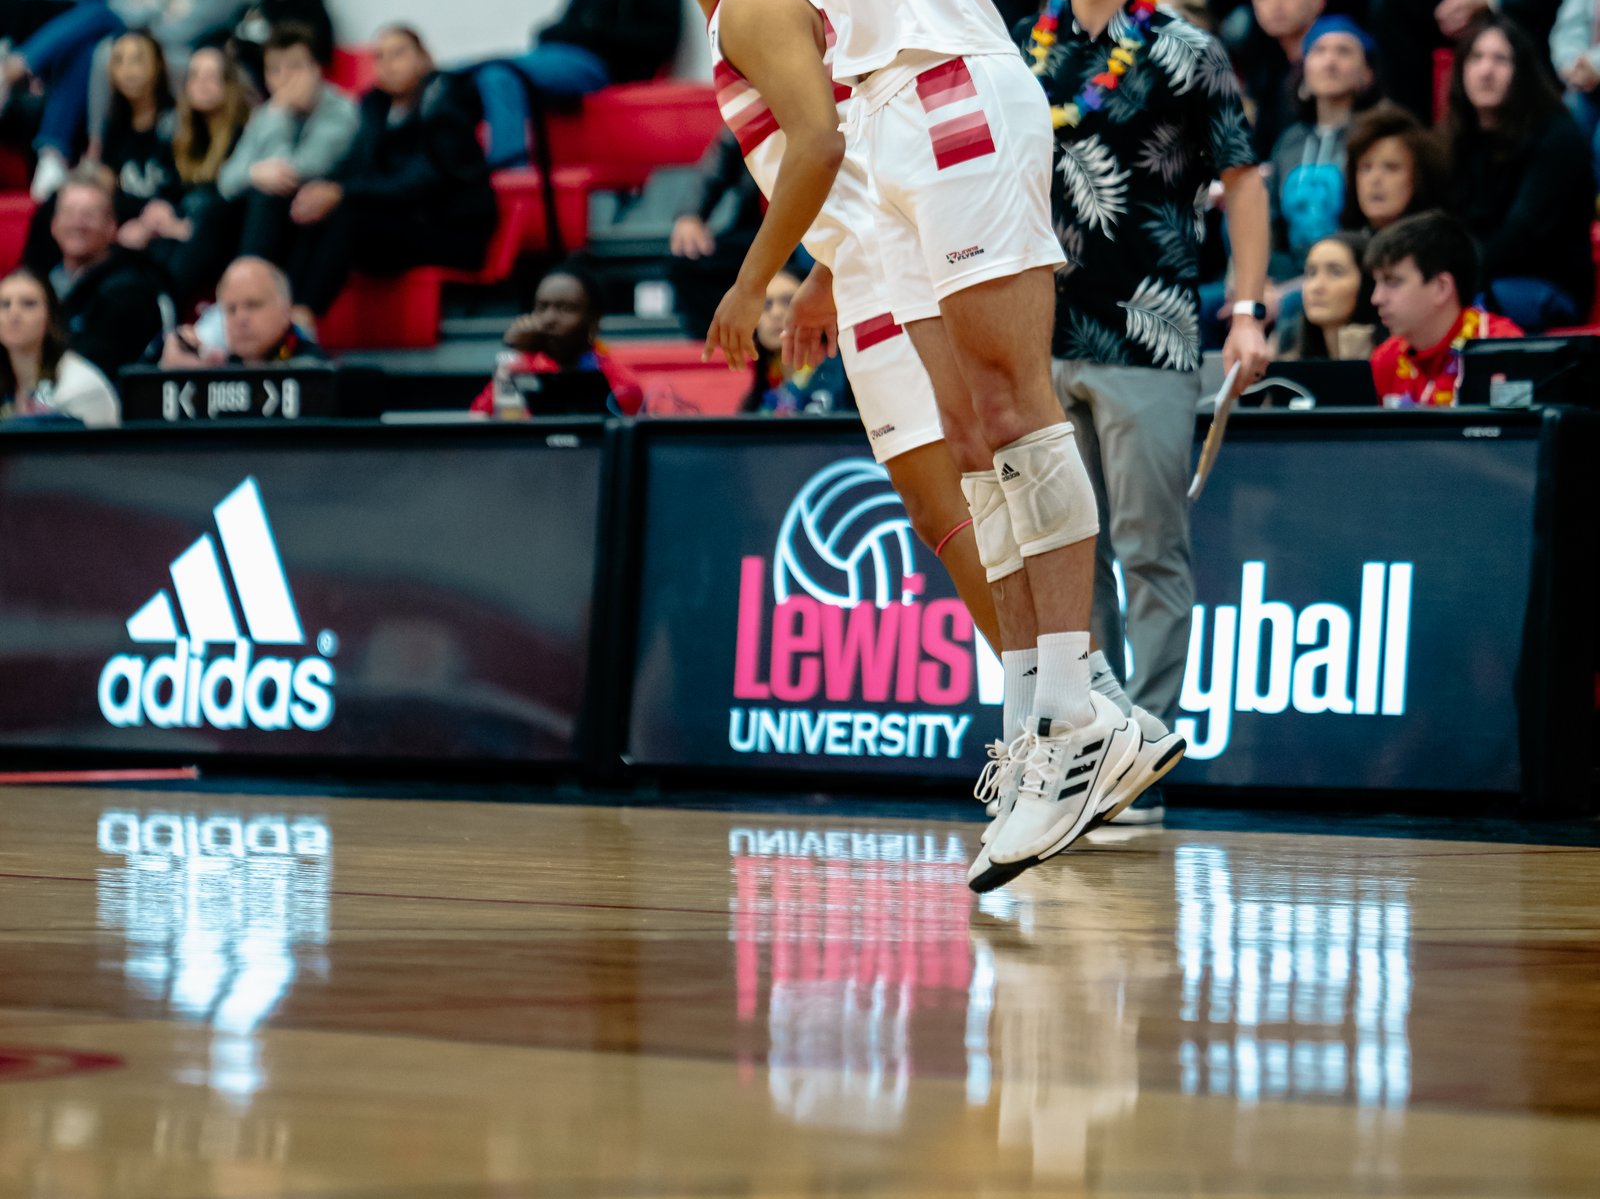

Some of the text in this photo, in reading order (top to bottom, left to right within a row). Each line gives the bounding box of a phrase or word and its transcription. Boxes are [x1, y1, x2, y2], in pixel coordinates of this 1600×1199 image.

[733, 555, 973, 706] Lewis
[97, 635, 337, 731] adidas
[728, 708, 973, 759] UNIVERSITY
